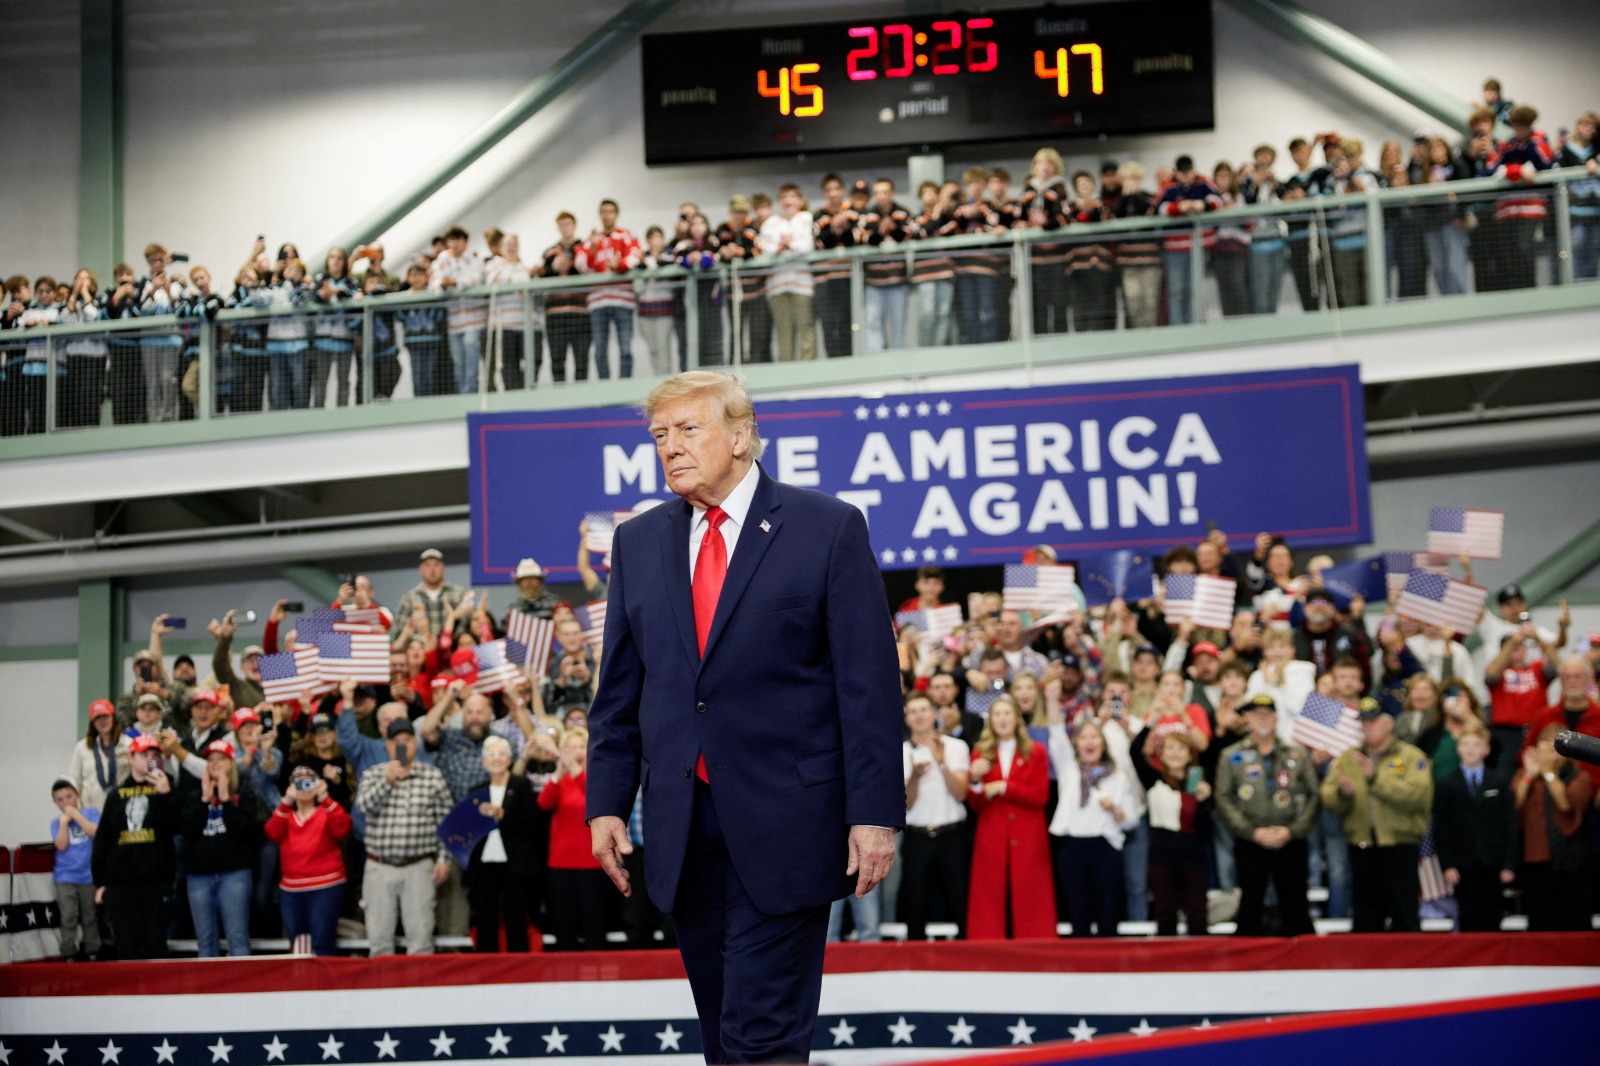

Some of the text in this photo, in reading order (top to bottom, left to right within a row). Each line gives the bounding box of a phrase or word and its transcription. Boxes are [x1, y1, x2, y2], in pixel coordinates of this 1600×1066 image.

[847, 17, 998, 81] 20:26
[1034, 43, 1103, 97] 47
[757, 63, 823, 117] 45
[898, 96, 949, 118] period
[603, 412, 1222, 495] ME AMERICA
[911, 471, 1199, 539] AGAIN!
